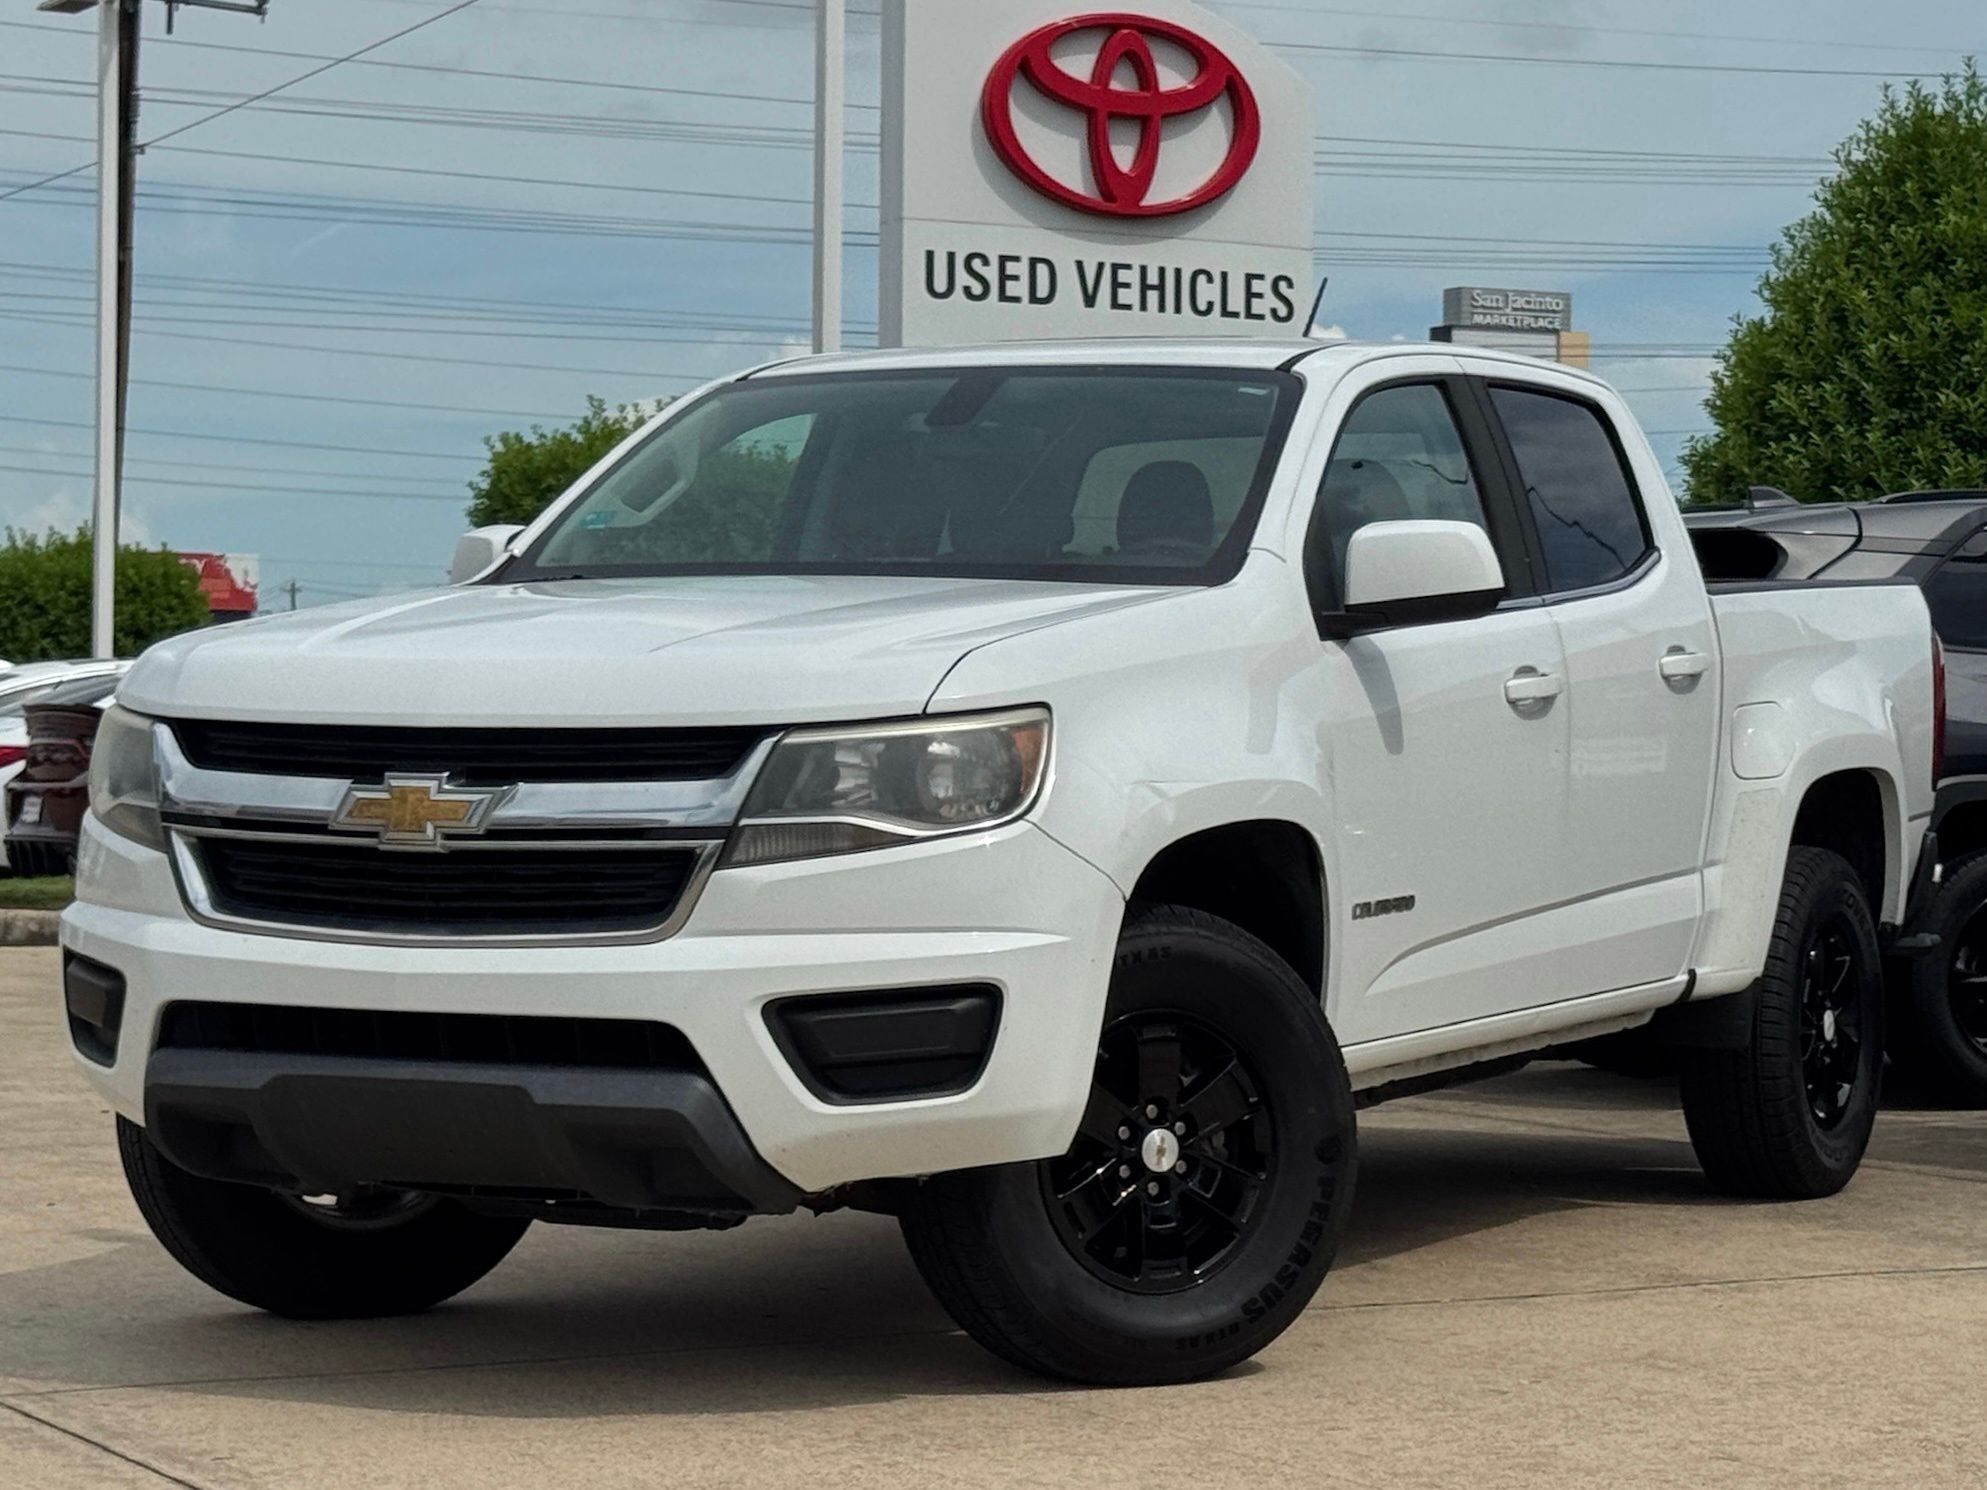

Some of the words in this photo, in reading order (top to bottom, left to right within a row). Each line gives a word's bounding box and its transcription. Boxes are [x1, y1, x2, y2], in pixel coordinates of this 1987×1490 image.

[925, 249, 1058, 306] USED
[1075, 259, 1296, 324] VEHICLES
[1471, 290, 1503, 308] San
[1507, 291, 1564, 312] Jacinto
[1471, 314, 1561, 329] MARKETPLACE
[1240, 1175, 1336, 1324] PEGASUS
